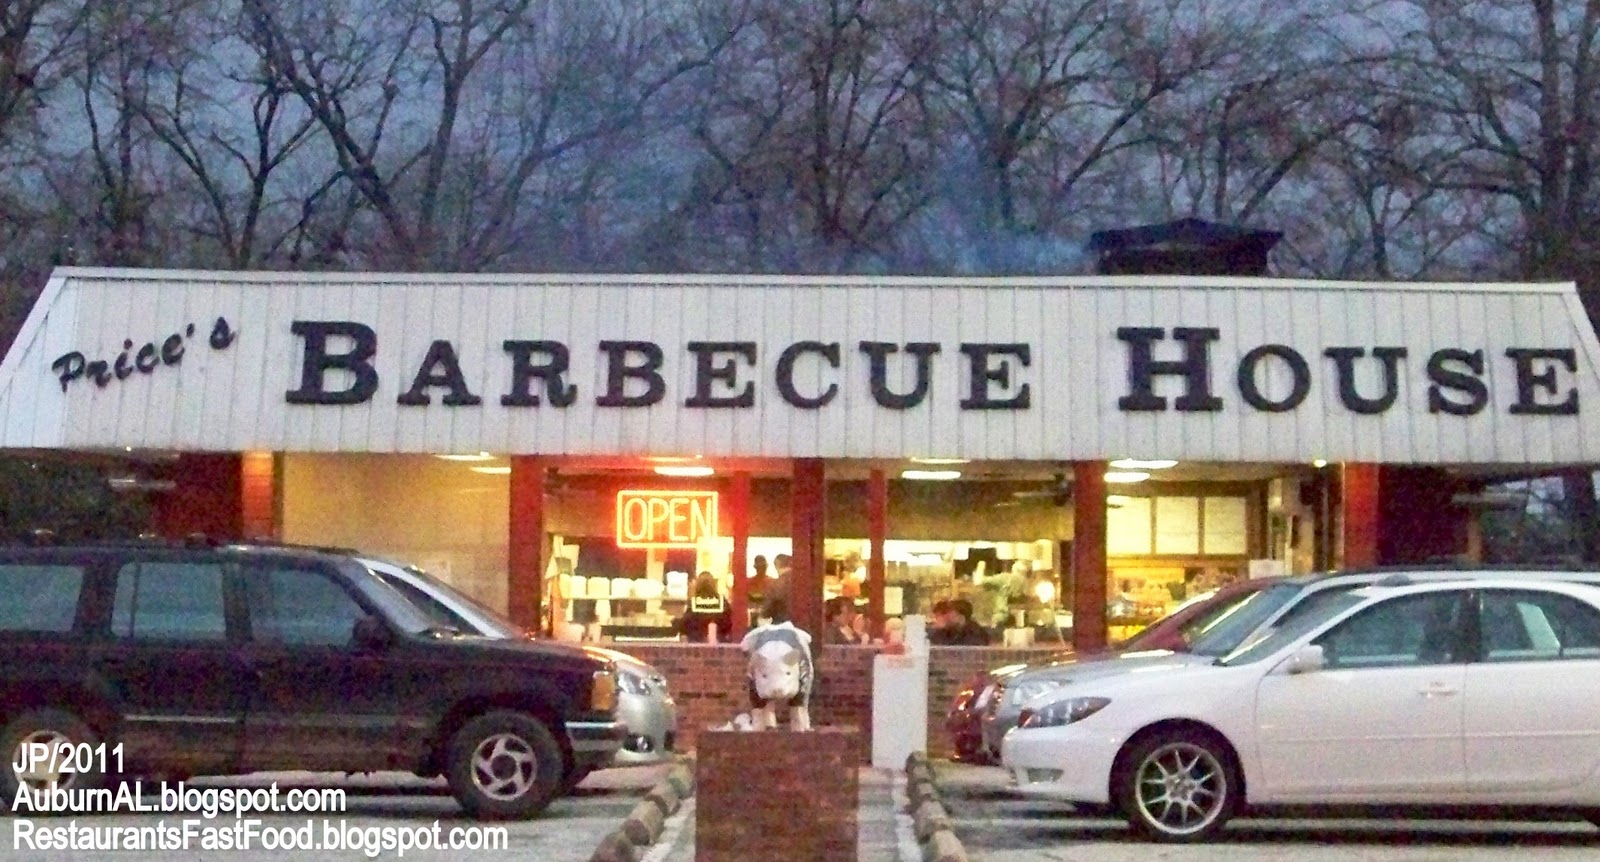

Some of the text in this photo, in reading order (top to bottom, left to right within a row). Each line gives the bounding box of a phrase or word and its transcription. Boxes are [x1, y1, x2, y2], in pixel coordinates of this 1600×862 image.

[52, 316, 236, 393] Price's
[285, 320, 1580, 416] BARBECUE HOUSE
[623, 497, 713, 542] OPEN
